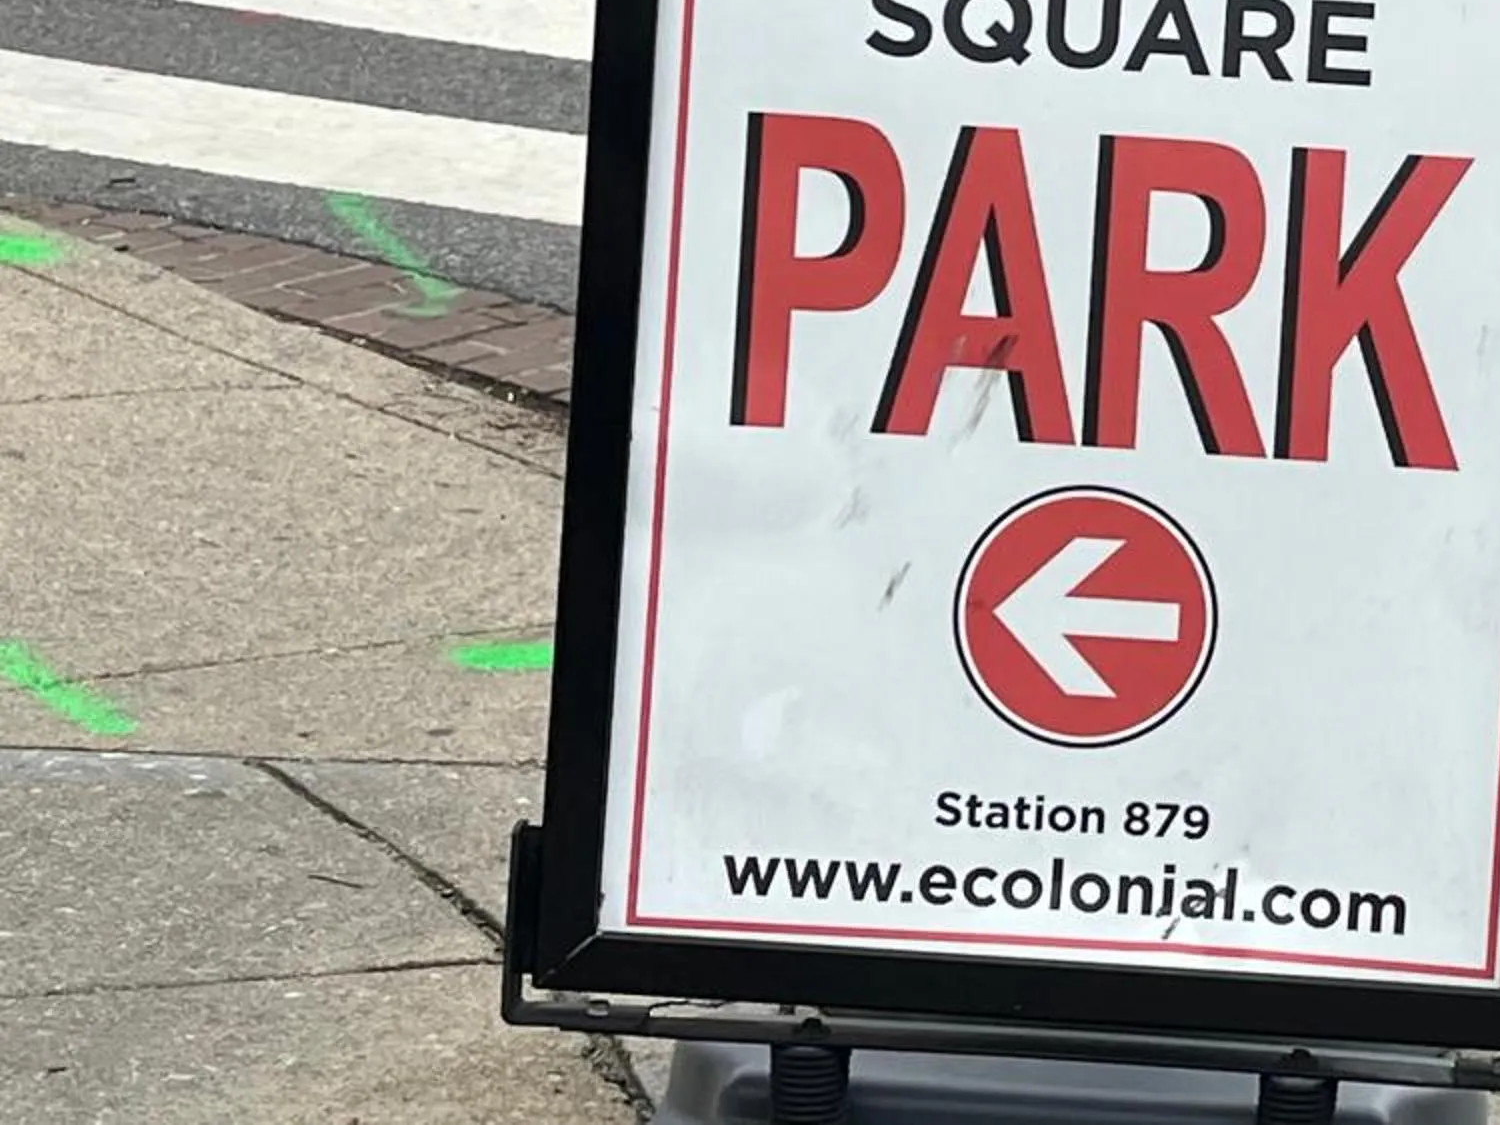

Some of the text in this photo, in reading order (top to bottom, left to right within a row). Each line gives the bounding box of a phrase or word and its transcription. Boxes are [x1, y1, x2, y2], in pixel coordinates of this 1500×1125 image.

[729, 111, 1475, 472] PARK
[935, 791, 1211, 840] Station 879
[723, 853, 1407, 936] www.ecolonial.com
